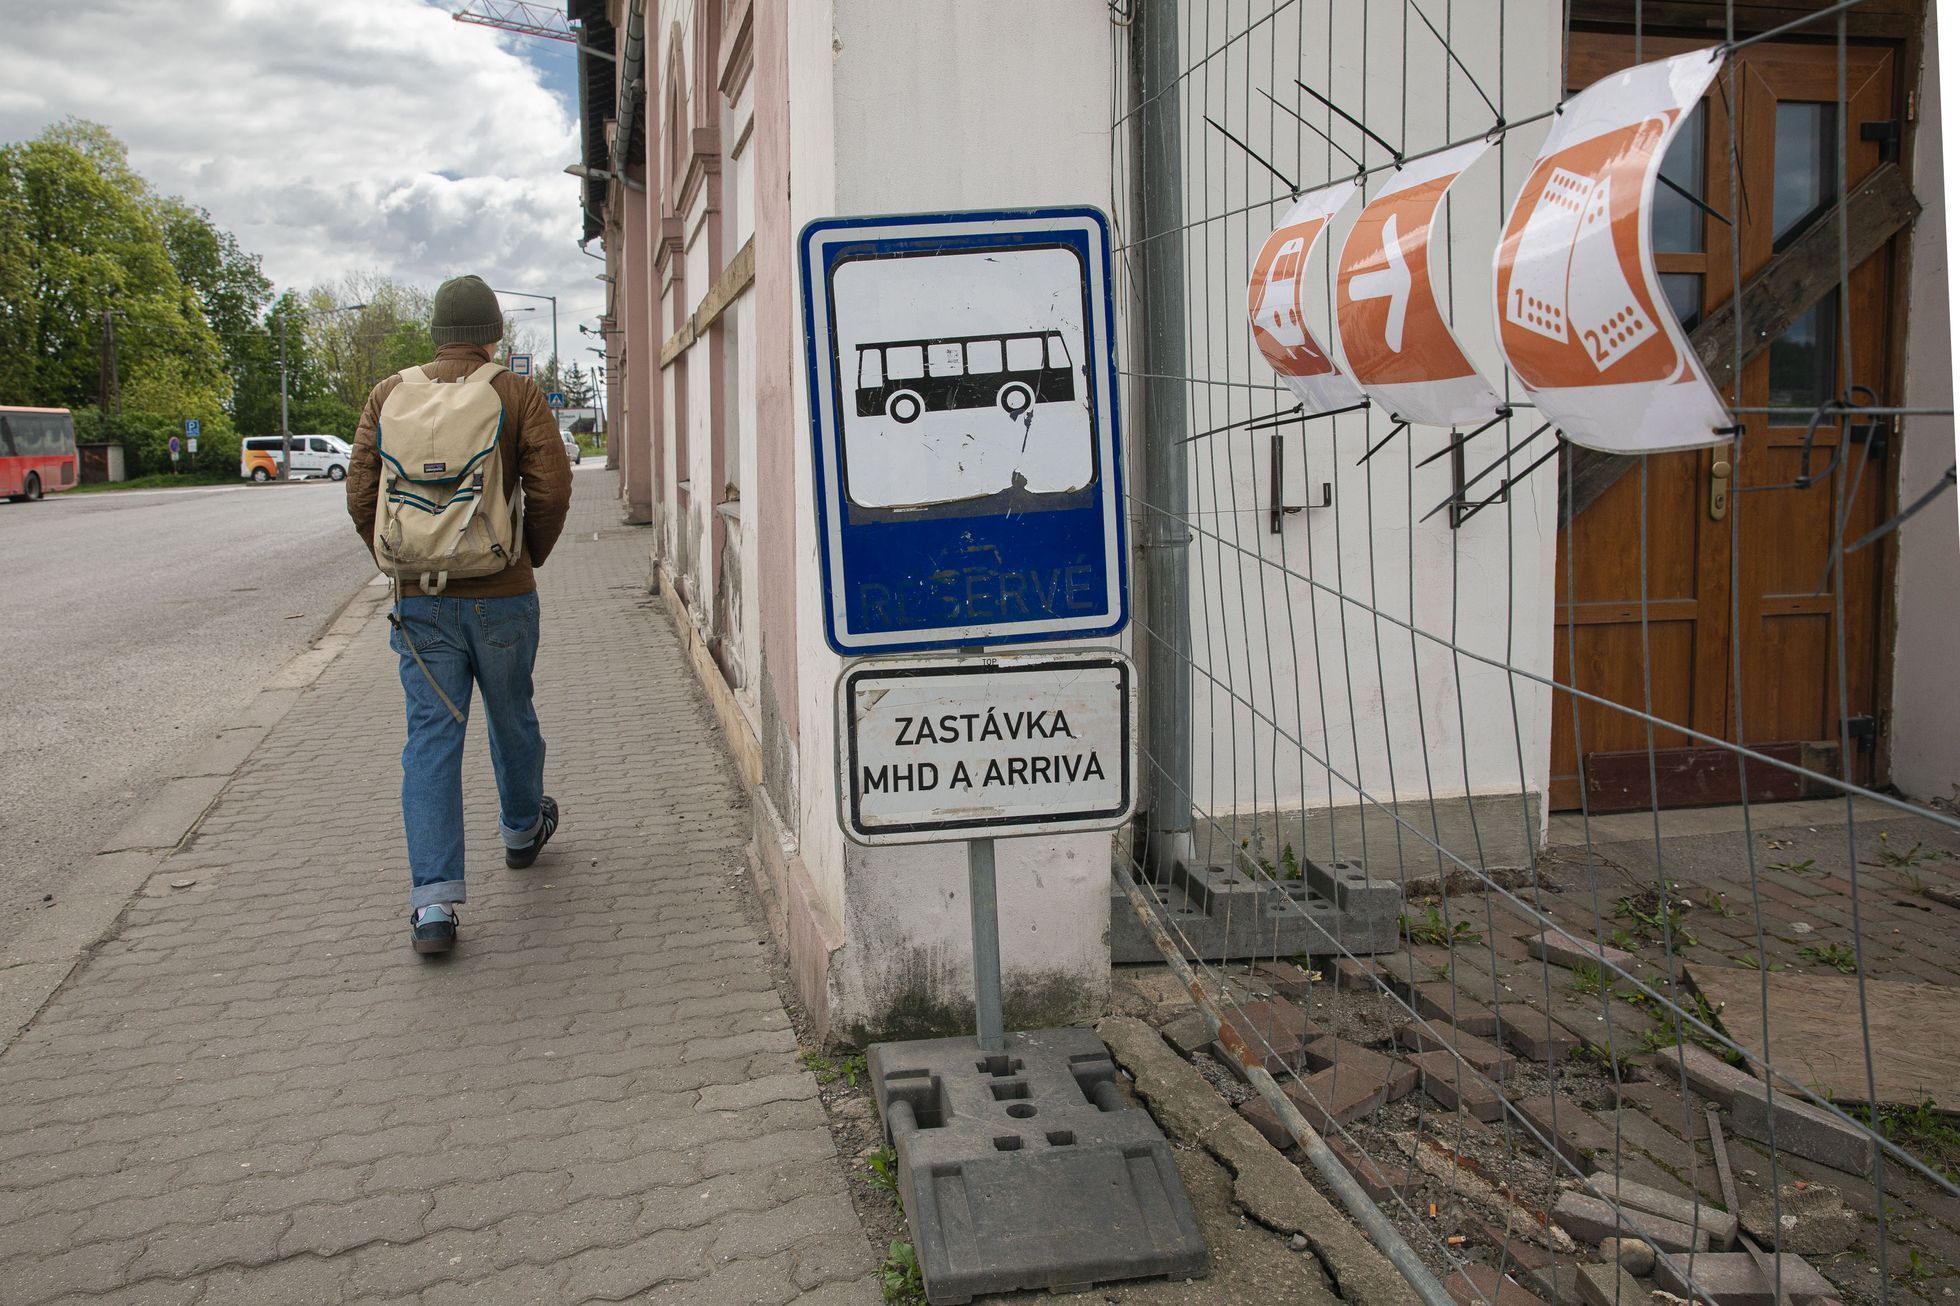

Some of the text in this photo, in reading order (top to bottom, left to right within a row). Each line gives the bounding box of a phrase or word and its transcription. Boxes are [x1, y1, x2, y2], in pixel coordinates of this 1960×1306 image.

[1515, 288, 1523, 319] 1
[1584, 329, 1610, 362] 2
[895, 706, 1071, 746] ZASTÁVKA
[863, 751, 1105, 795] MHD A ARRIVA
